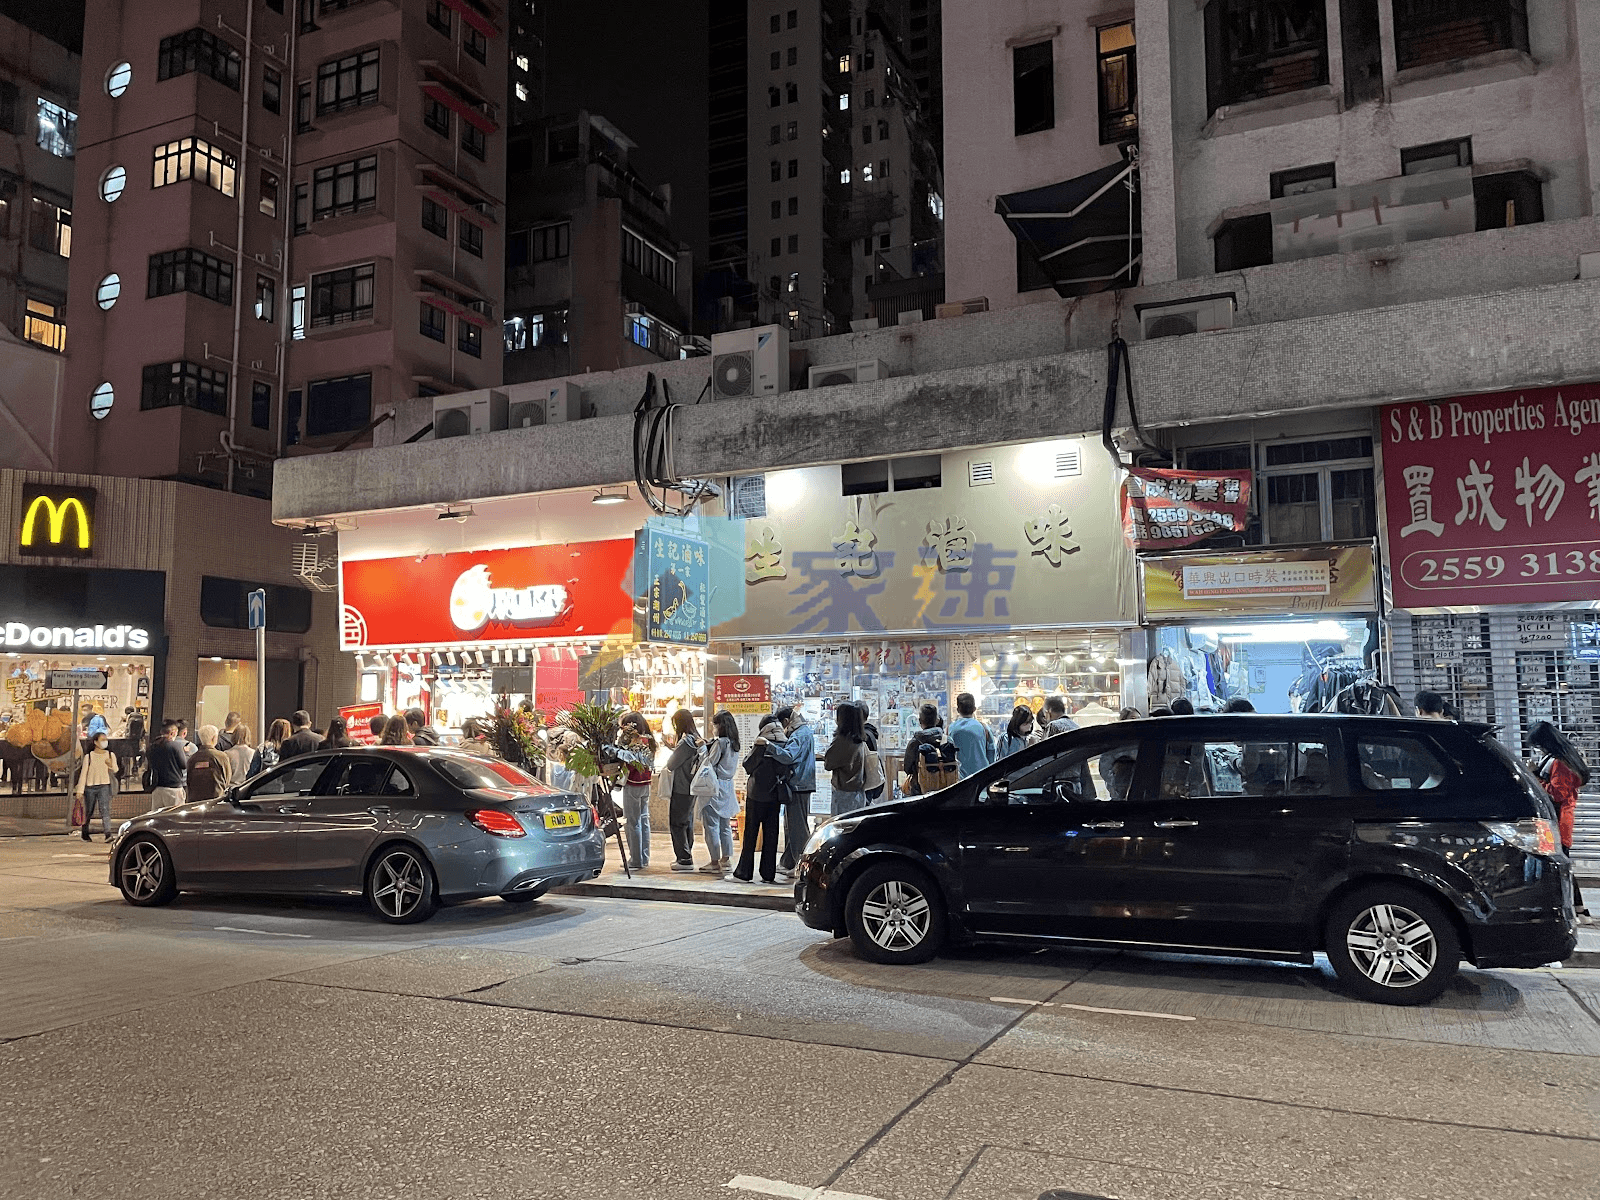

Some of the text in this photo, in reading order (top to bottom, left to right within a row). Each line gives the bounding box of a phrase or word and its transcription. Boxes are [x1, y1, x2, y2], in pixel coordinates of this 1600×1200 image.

[1391, 409, 1403, 443] S
[1408, 406, 1424, 441] &
[1429, 404, 1444, 439] B
[1450, 395, 1546, 444] Properties
[1188, 569, 1279, 586] 華興出口時裝
[1420, 556, 1505, 582] 2559
[0, 622, 149, 649] Donald's
